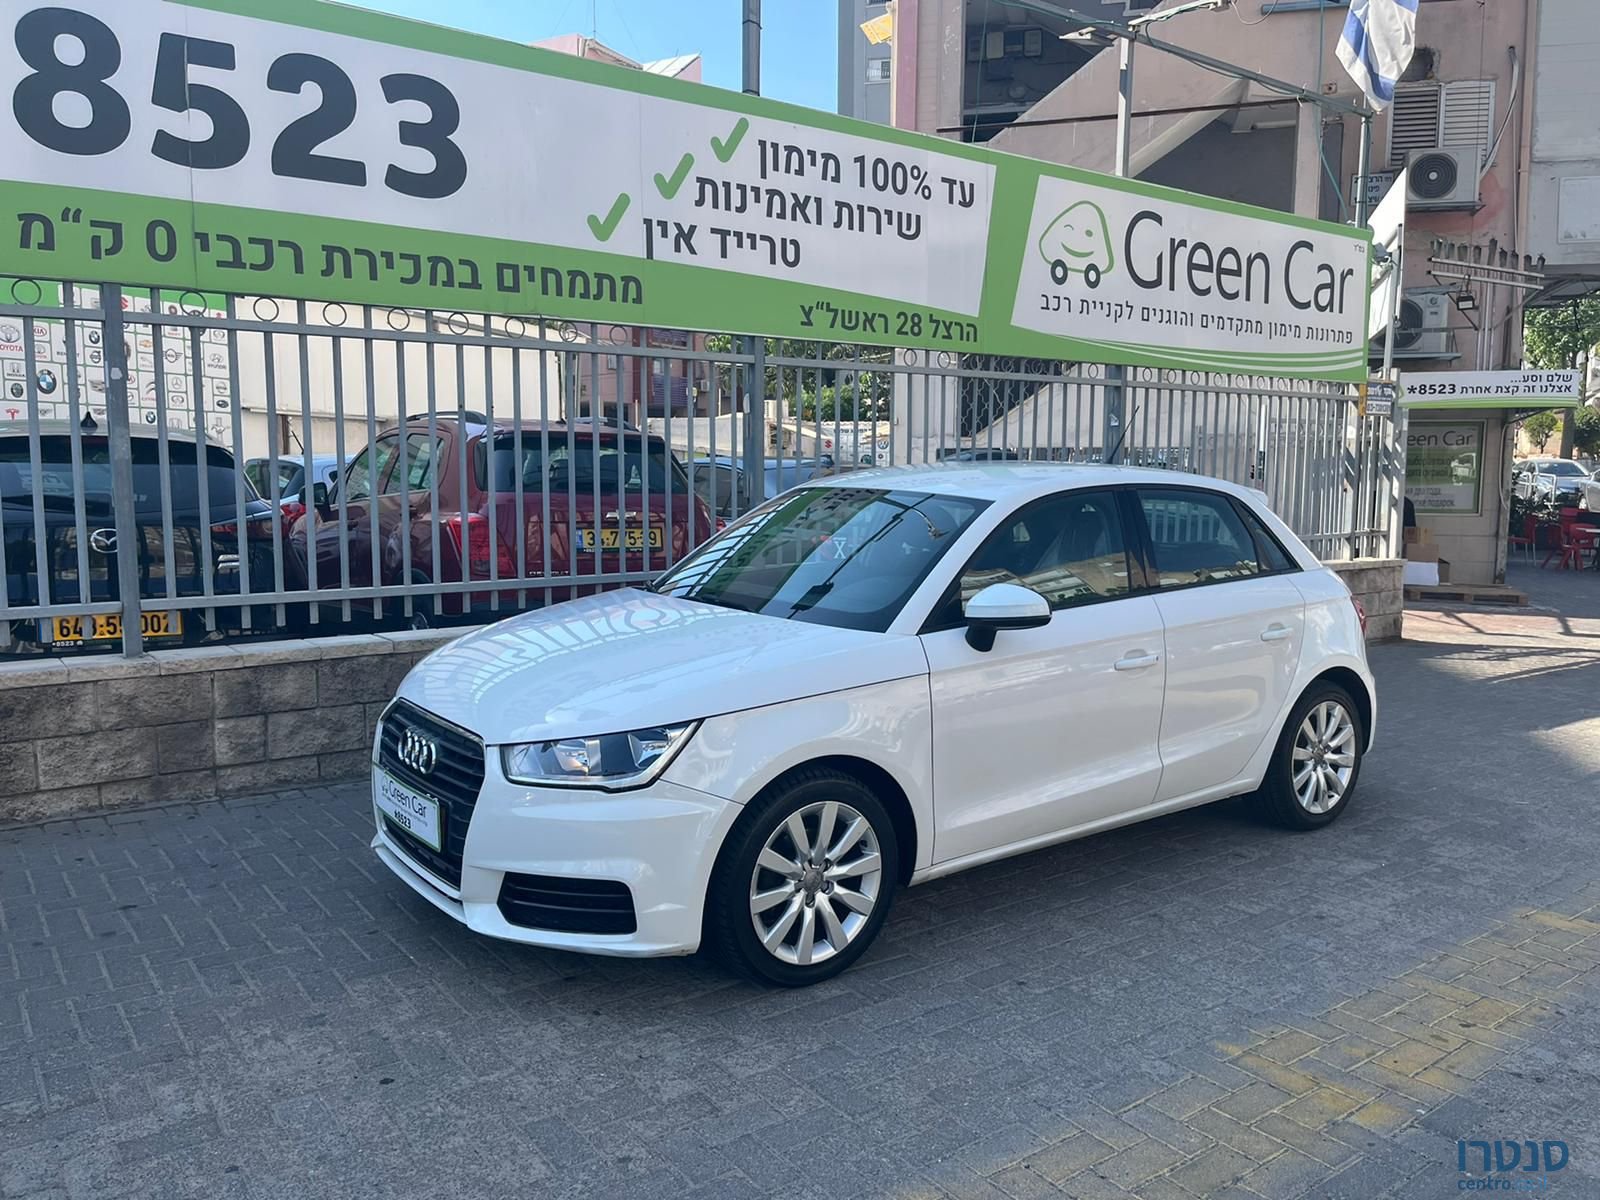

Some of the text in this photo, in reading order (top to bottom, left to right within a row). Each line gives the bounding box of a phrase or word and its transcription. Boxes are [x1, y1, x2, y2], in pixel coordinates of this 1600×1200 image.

[12, 7, 467, 199] 8523
[758, 139, 975, 208] עד 100% מימון
[694, 176, 921, 241] שירות ואמינות
[145, 219, 177, 262] 0
[193, 231, 304, 276] רכבי
[643, 218, 801, 268] טרייד אין
[1124, 210, 1354, 314] Green Car
[320, 244, 483, 290] במכירת
[495, 262, 643, 305] מתמחים
[896, 311, 922, 337] 28
[929, 312, 978, 343] הרצל
[1040, 294, 1353, 345] פתרונות מימון מתקדמים והוגנים לקניית רכב
[1460, 386, 1492, 395] אחרת
[1494, 385, 1520, 397] קצת
[1522, 384, 1537, 394] זה
[1538, 383, 1573, 394] אצלנו
[1546, 372, 1574, 383] שלם
[1442, 430, 1473, 446] Car
[389, 780, 411, 810] Green
[411, 795, 427, 818] Car
